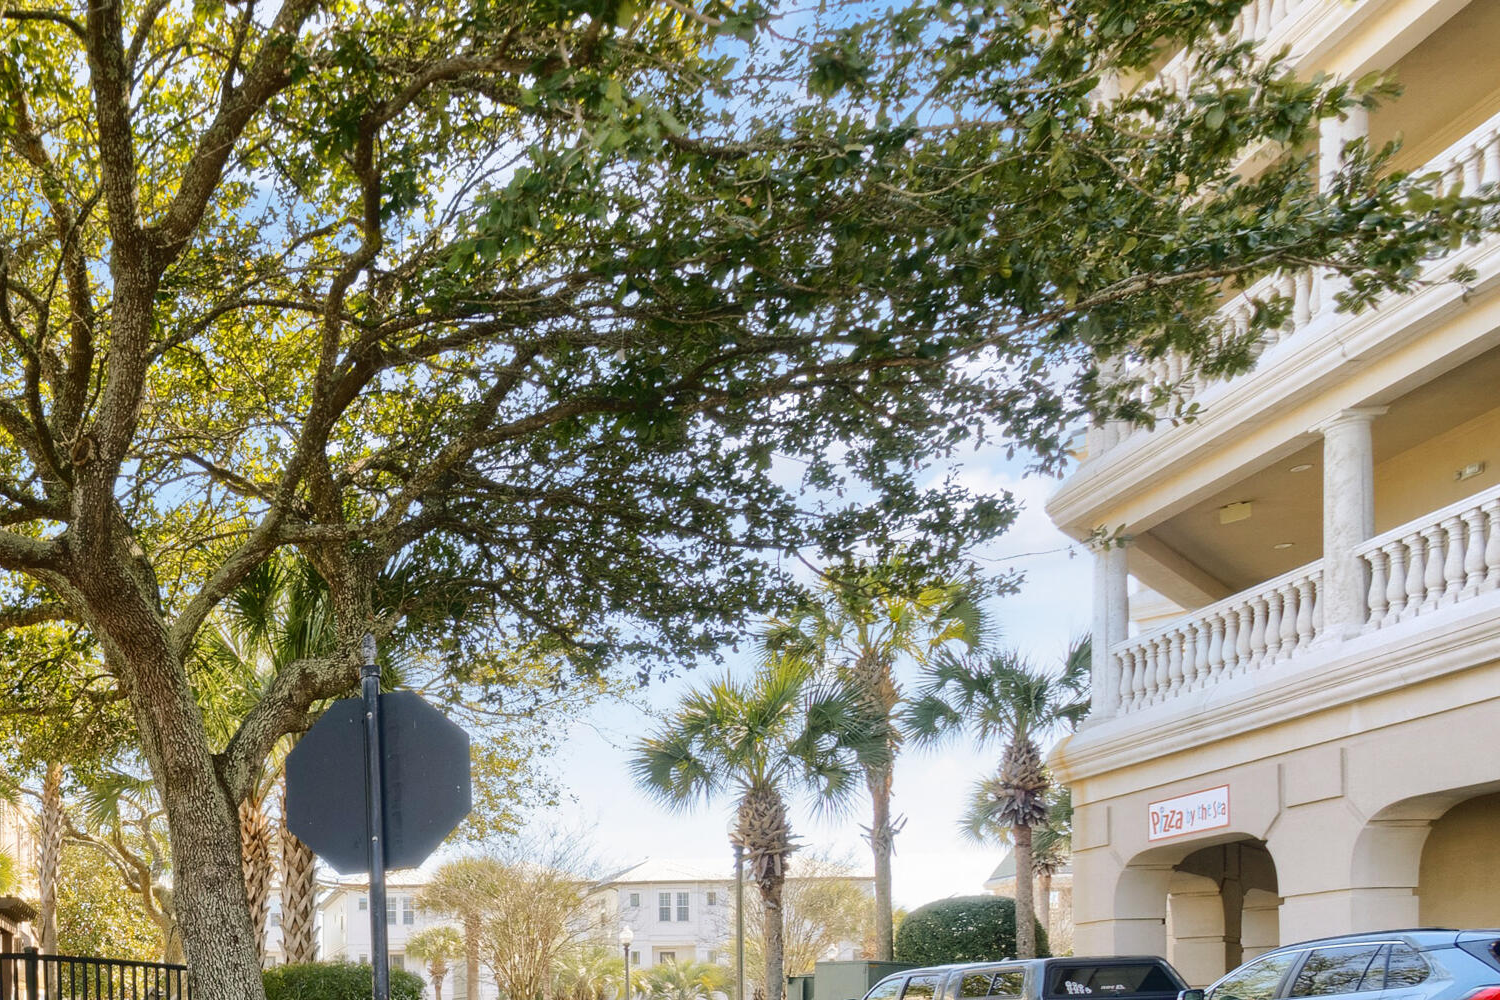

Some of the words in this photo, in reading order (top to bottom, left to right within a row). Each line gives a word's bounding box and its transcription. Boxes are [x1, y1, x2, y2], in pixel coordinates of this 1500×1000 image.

[1151, 806, 1183, 834] Pizza
[1186, 809, 1195, 826] by
[1197, 804, 1211, 820] the
